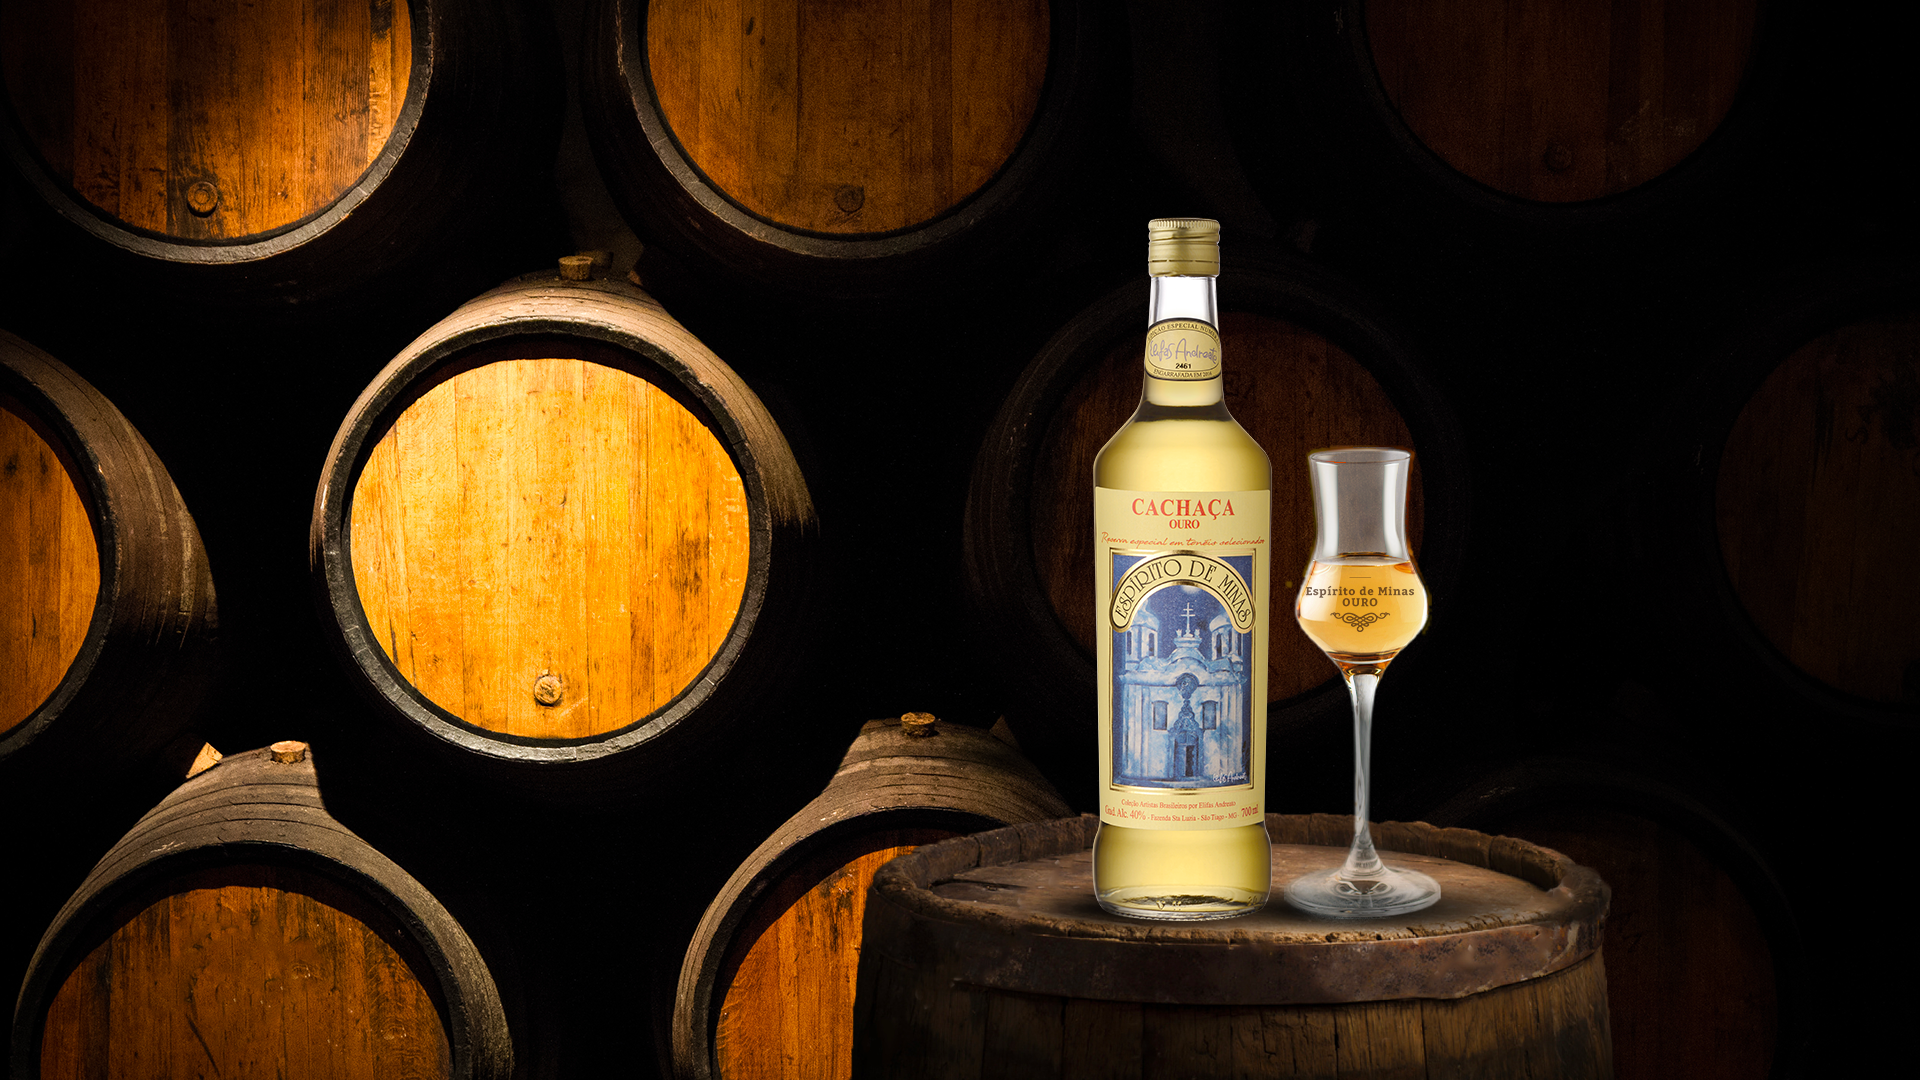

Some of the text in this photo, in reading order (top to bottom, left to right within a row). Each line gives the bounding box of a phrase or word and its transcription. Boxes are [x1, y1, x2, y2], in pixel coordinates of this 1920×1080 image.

[1166, 322, 1199, 330] ESPECIAL
[1153, 368, 1193, 378] ENGARRAFADA
[1131, 498, 1236, 520] CACHAÇA
[1168, 519, 1200, 529] OURO
[1101, 531, 1128, 544] Reserva
[1130, 537, 1169, 549] especial
[1188, 559, 1217, 582] DE
[1217, 574, 1252, 624] MINAS
[1305, 585, 1415, 598] Espírito de Minas
[1342, 597, 1378, 607] OURO
[1121, 798, 1139, 807] Coleção
[1188, 803, 1198, 811] por
[1116, 808, 1129, 819] Alc.
[1129, 809, 1147, 821] 40%
[1150, 814, 1171, 822] Fazenda
[1200, 814, 1211, 822] São
[1211, 813, 1225, 822] Tiago
[1228, 812, 1238, 820] MG
[1240, 806, 1252, 818] 700
[1252, 804, 1259, 815] ml
